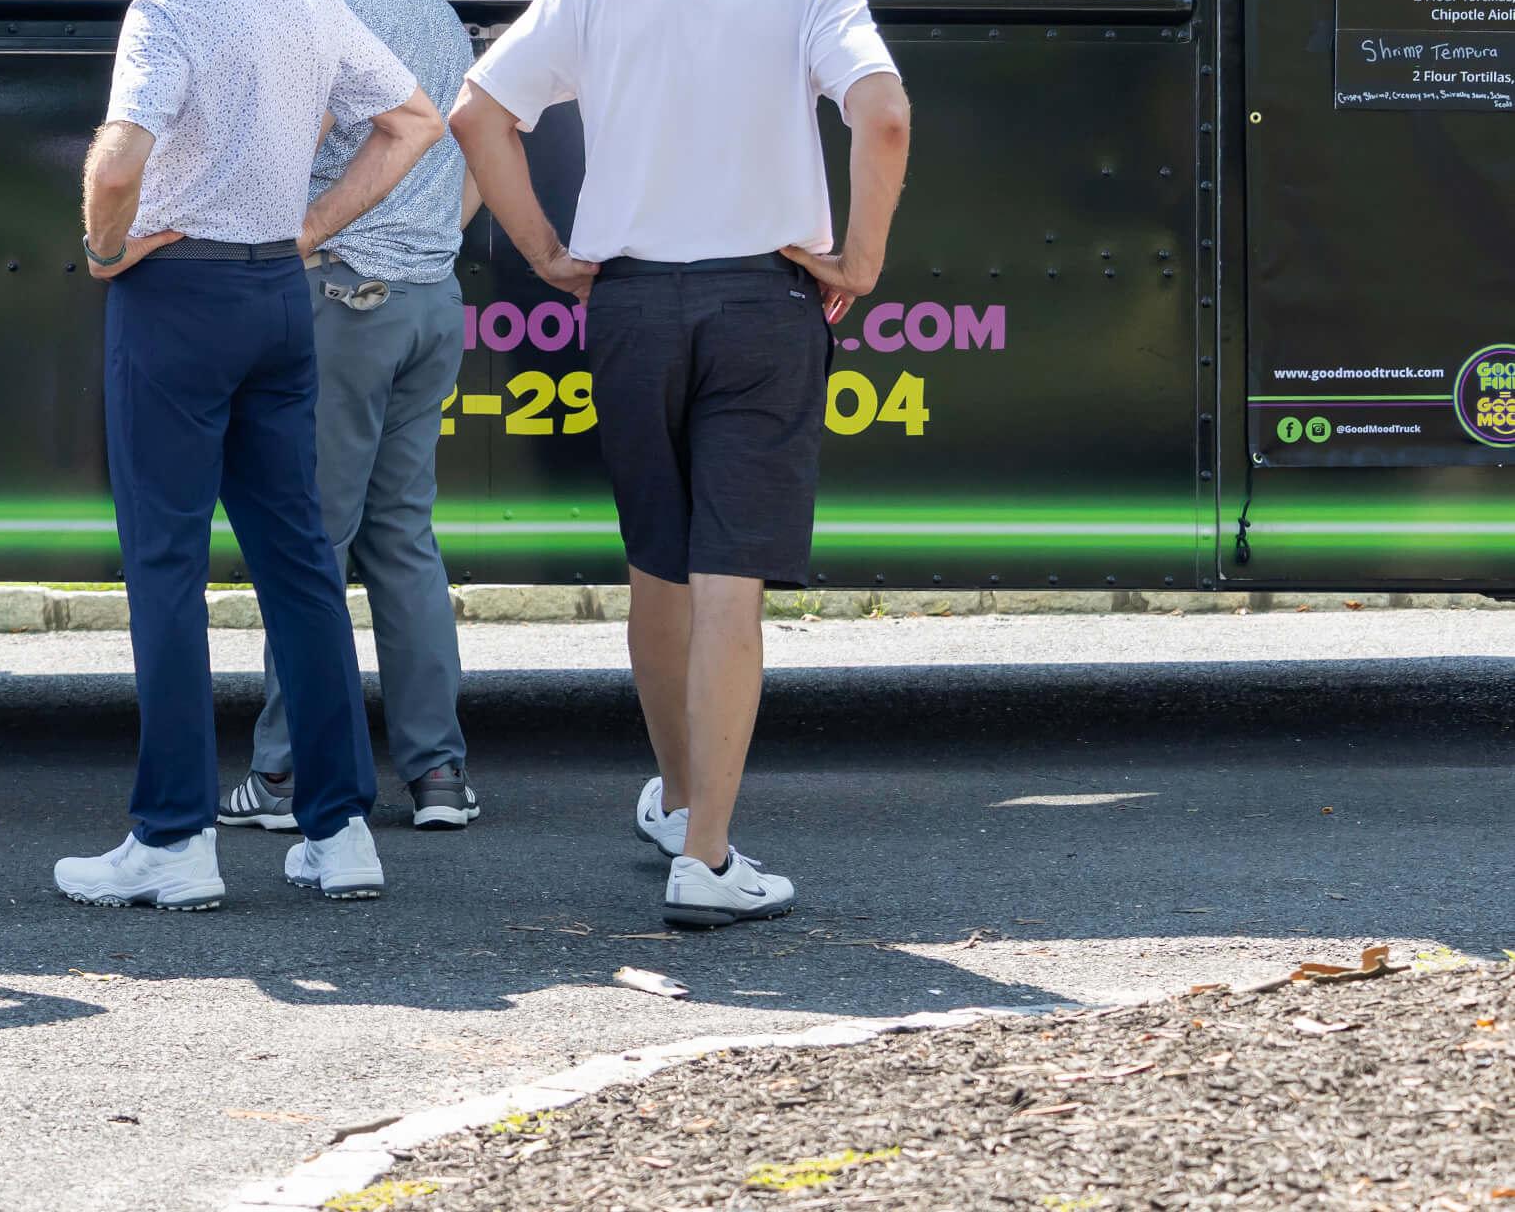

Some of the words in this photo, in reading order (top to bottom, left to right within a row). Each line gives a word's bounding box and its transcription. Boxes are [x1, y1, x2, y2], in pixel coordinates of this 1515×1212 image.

[1431, 8, 1485, 23] Chipotle
[1361, 38, 1424, 63] Shrimp
[1430, 42, 1498, 61] Tempura
[1413, 70, 1420, 82] 2
[1424, 70, 1457, 83] Flour
[1460, 71, 1515, 85] Tortillas,
[1274, 367, 1444, 381] www.goodmoodtruck.com
[1336, 424, 1421, 435] @GoodMoodTruck
